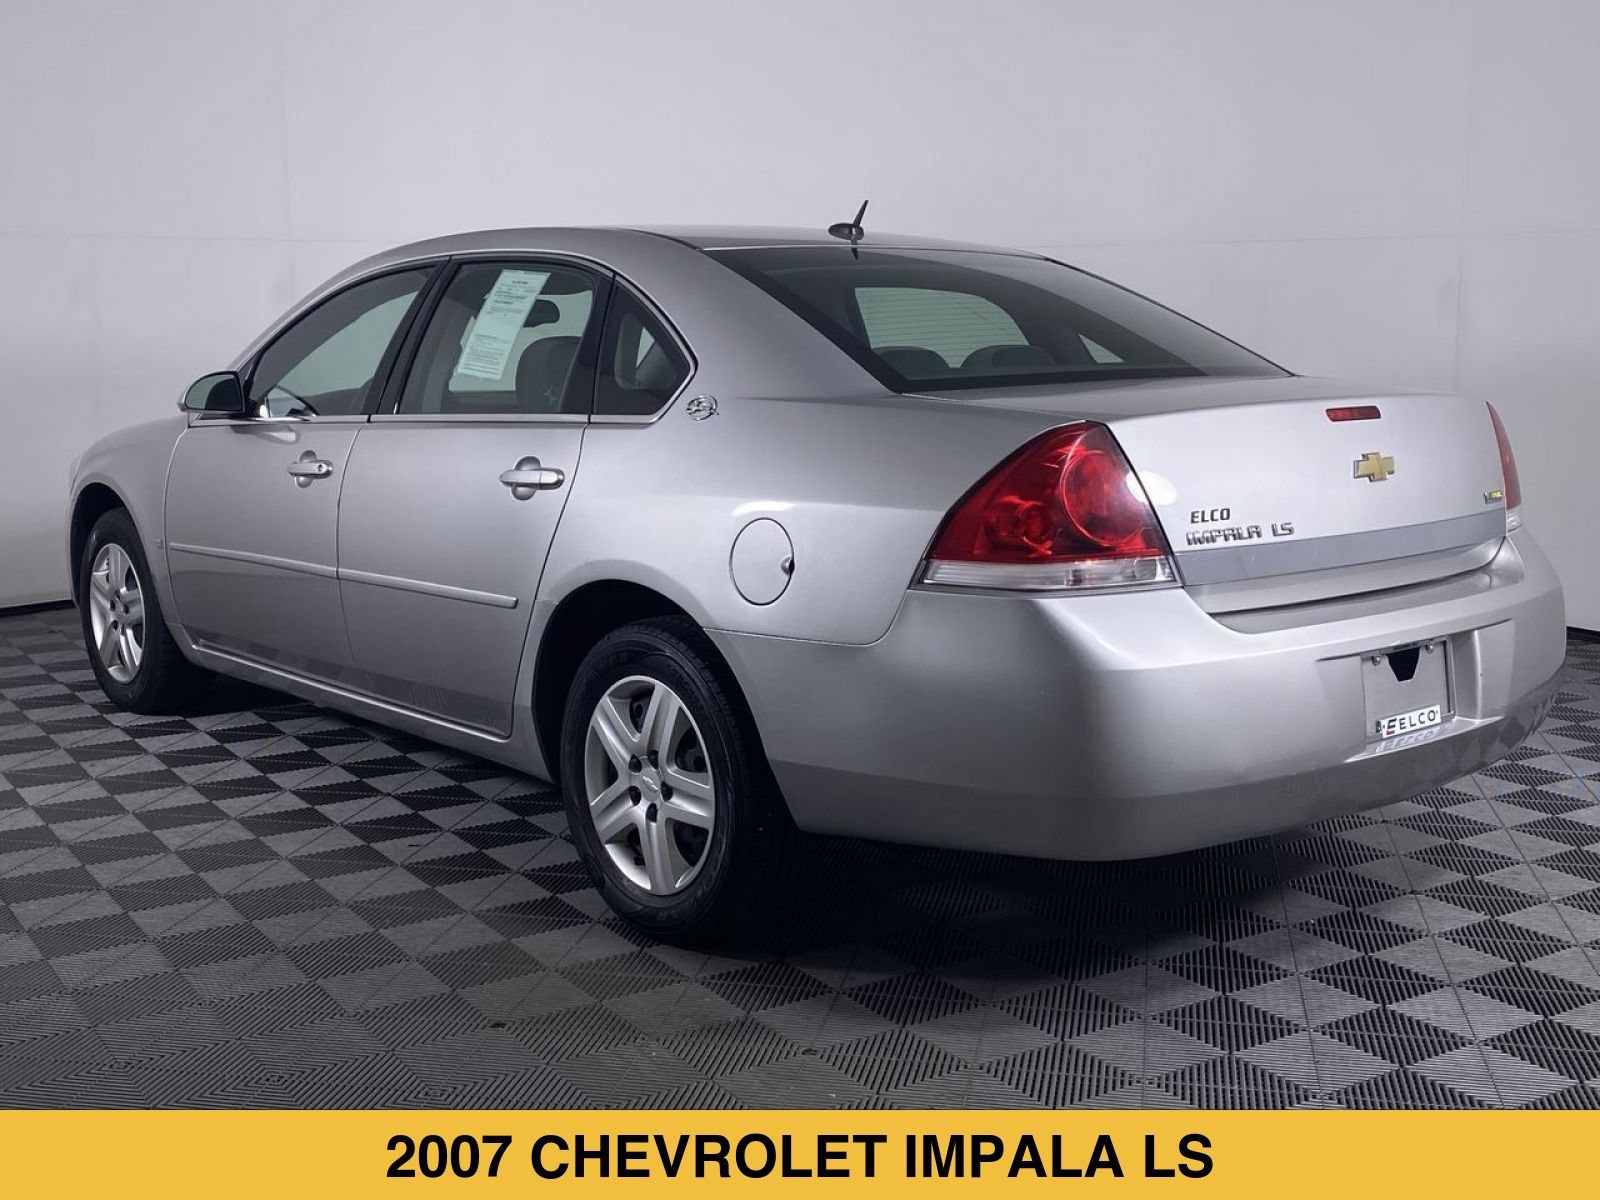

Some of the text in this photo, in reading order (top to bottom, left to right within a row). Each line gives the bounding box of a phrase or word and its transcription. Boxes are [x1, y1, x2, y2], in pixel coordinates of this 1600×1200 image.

[1190, 507, 1231, 524] ELCO
[1186, 522, 1295, 546] IMPALA LS
